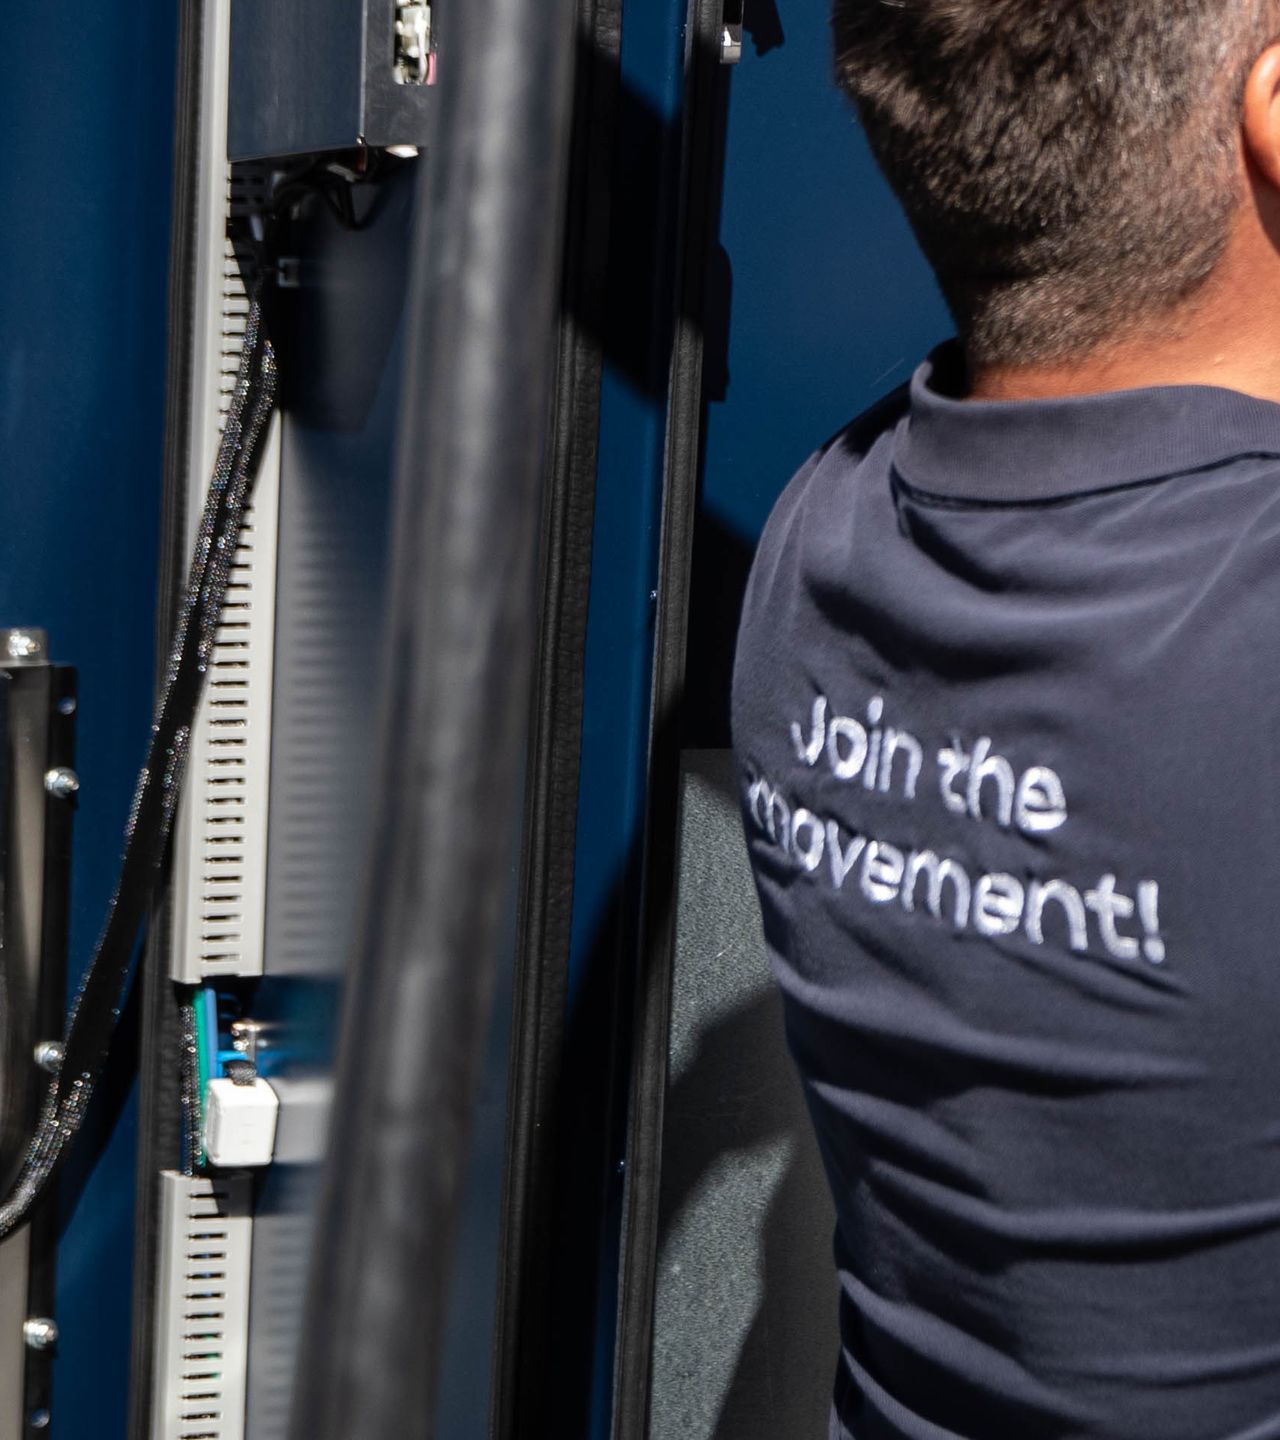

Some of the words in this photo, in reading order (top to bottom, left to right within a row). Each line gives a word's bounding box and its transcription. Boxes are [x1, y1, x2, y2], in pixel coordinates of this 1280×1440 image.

[790, 695, 923, 800] Join
[936, 728, 1067, 832] the
[748, 777, 1166, 964] movement!
